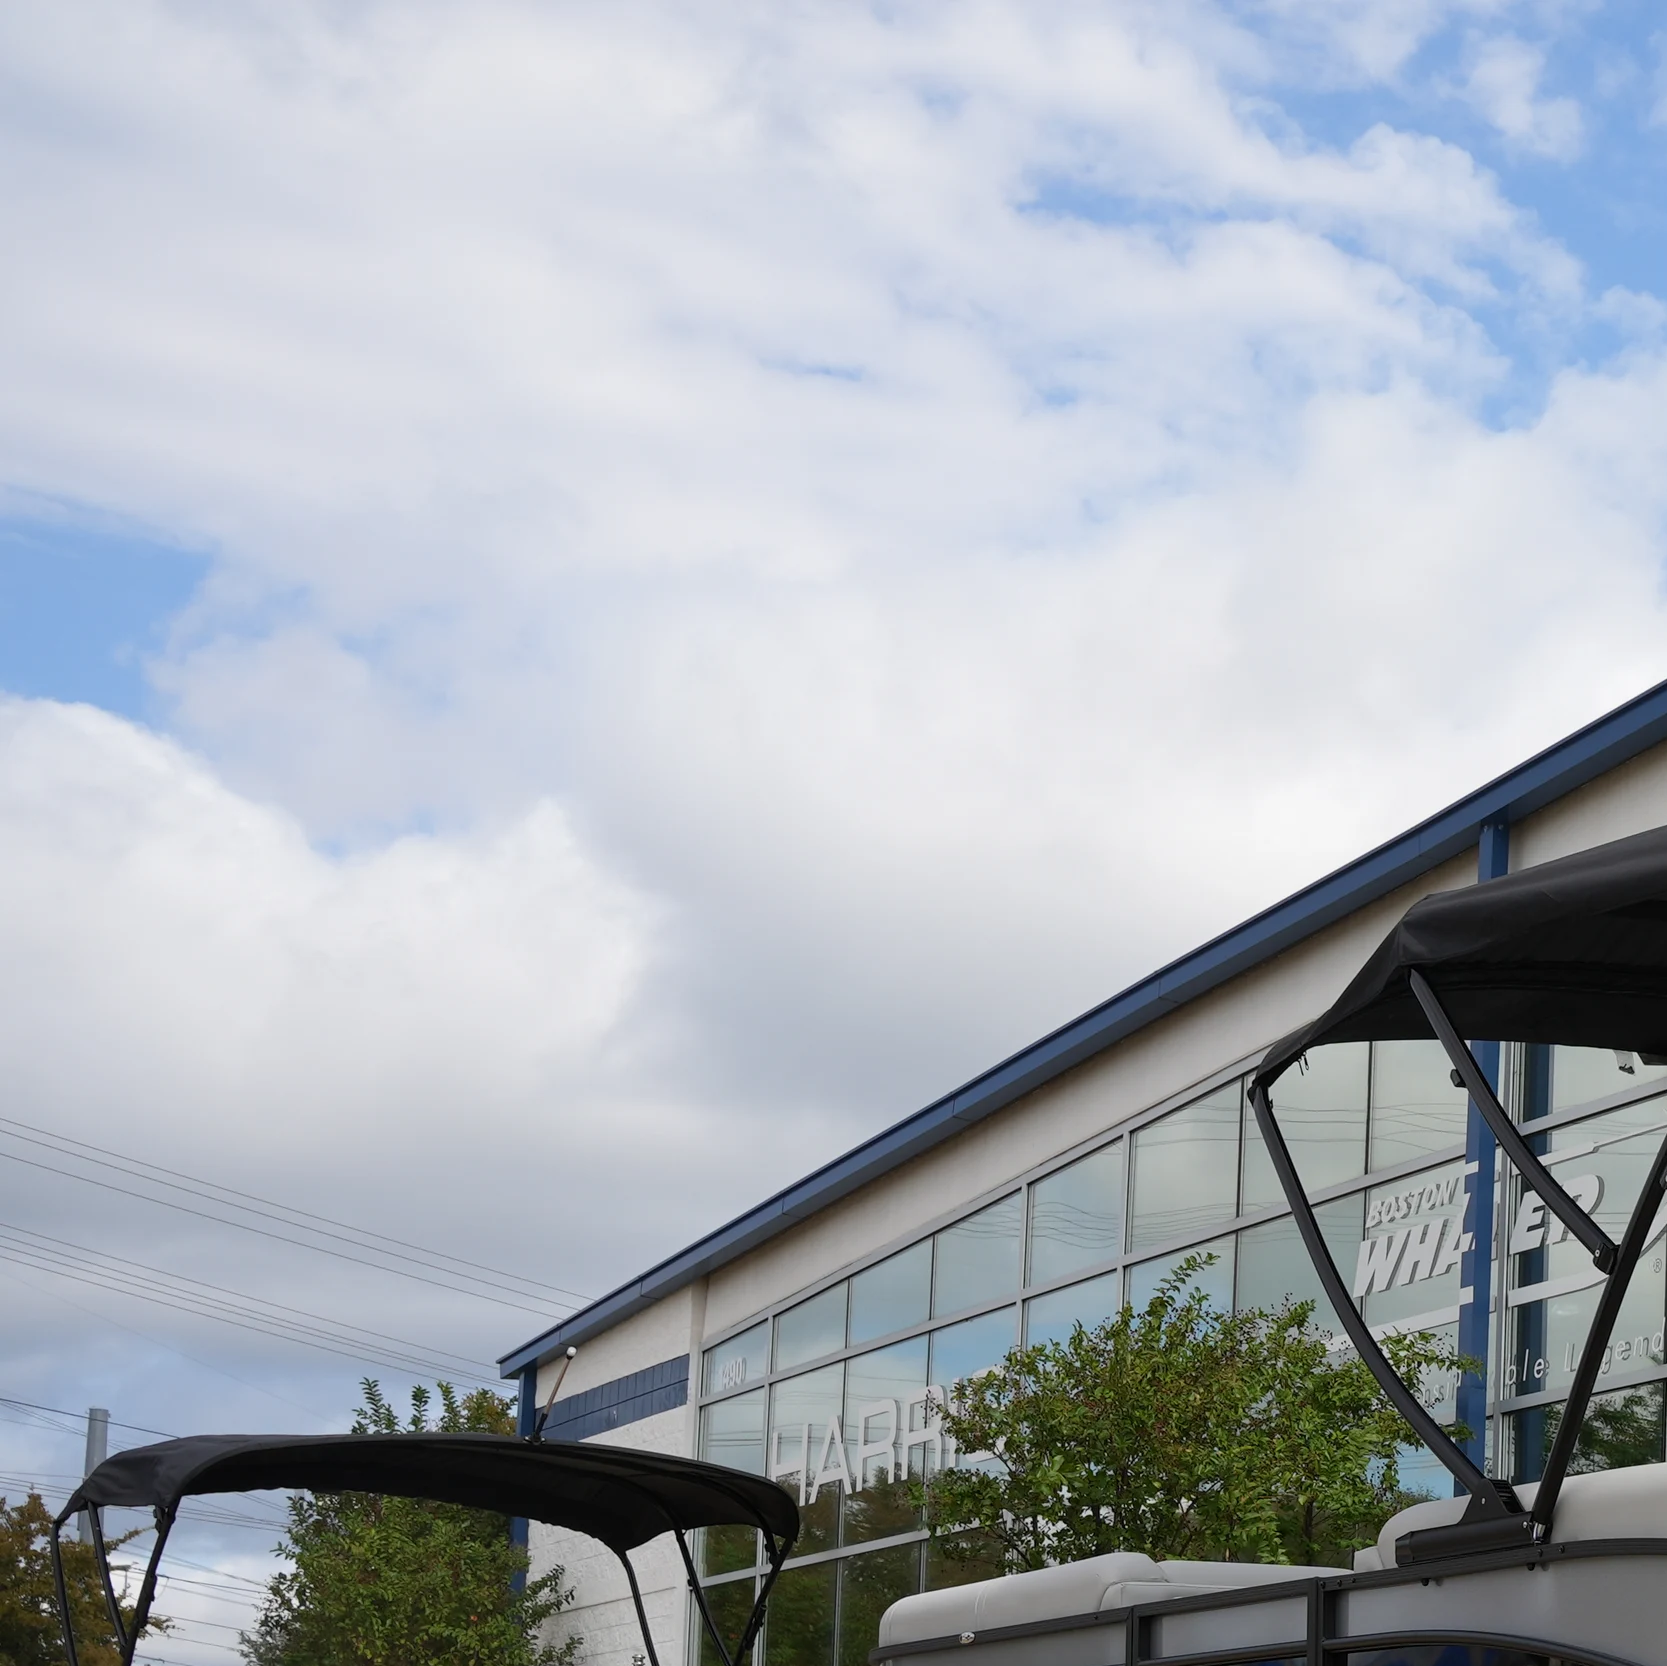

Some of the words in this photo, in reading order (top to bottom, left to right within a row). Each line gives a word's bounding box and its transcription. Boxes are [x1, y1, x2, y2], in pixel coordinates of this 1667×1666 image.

[1365, 1177, 1459, 1230] BOSTON
[1352, 1173, 1606, 1299] WHAER
[1563, 1316, 1667, 1375] Lgend
